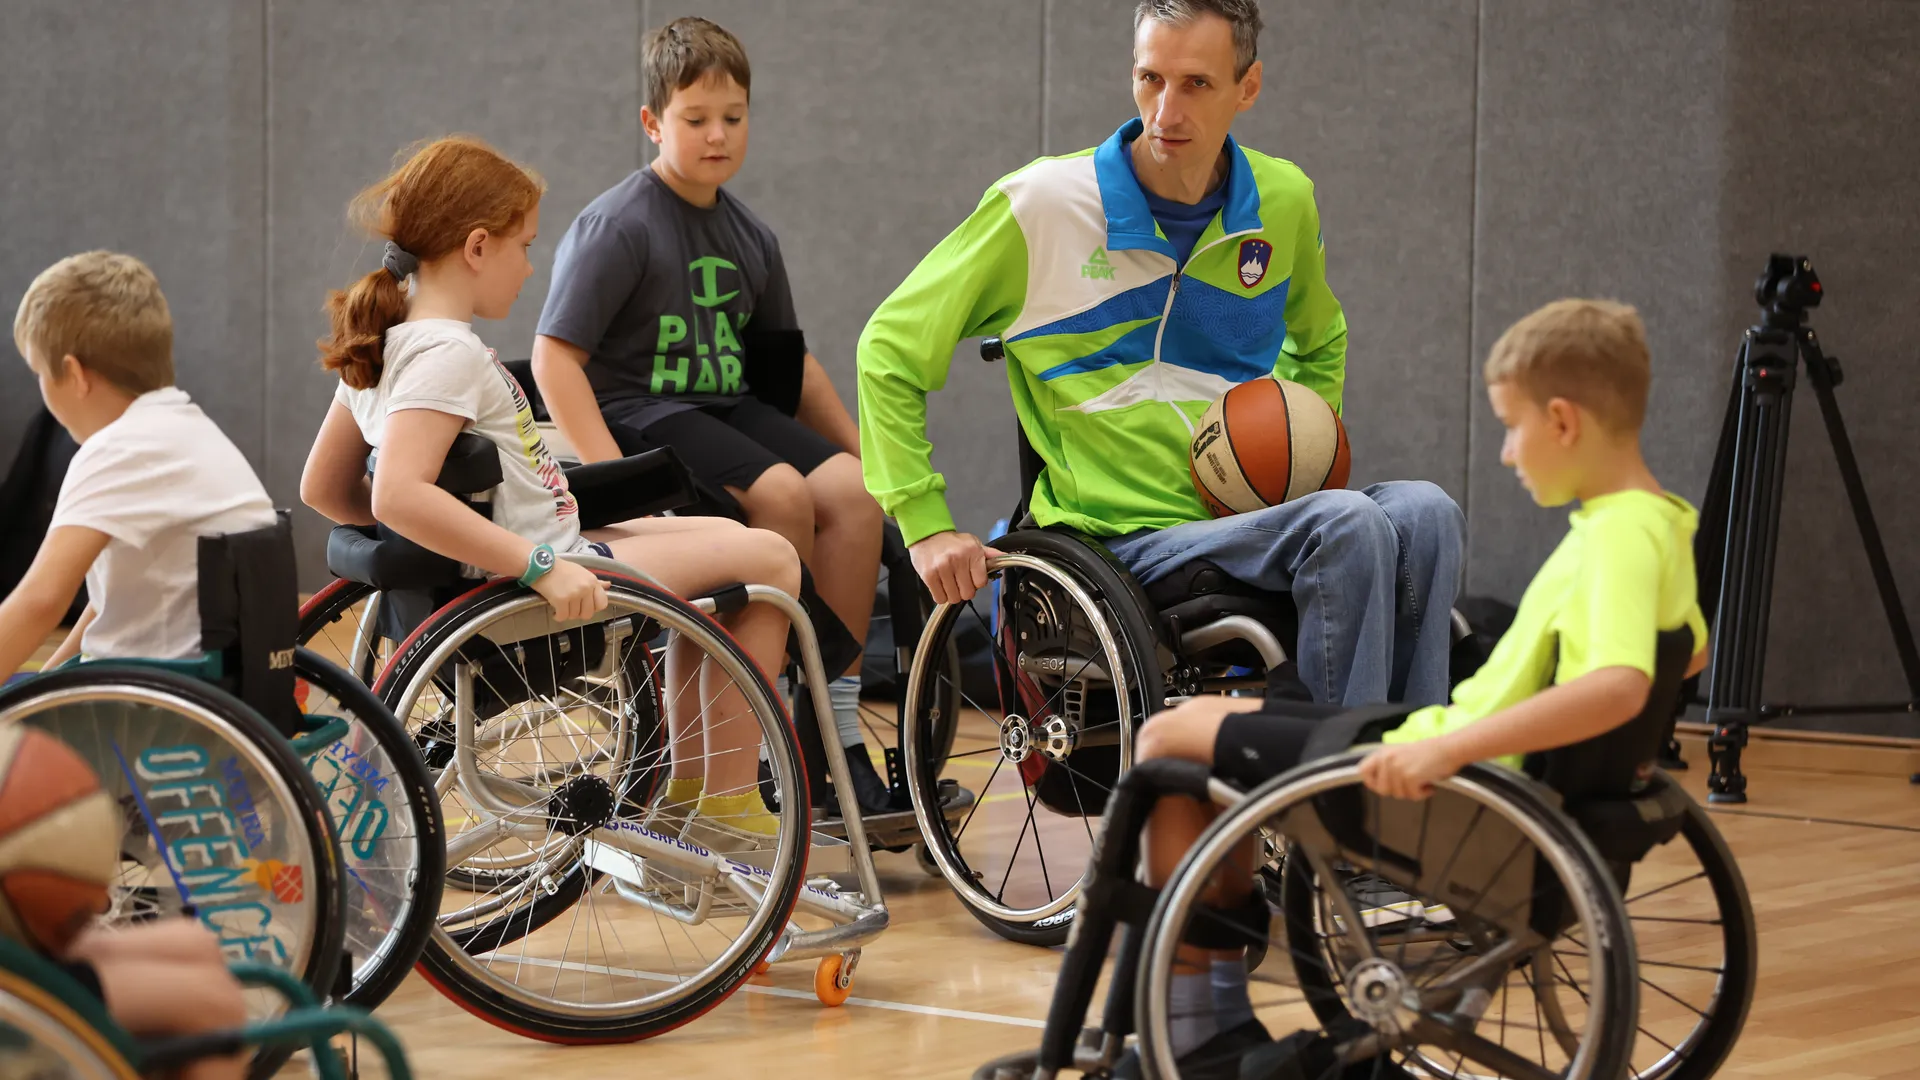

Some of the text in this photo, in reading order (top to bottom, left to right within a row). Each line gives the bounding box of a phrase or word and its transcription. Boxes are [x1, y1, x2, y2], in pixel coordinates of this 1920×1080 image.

[1081, 264, 1117, 281] PEAK
[650, 355, 742, 394] HAR
[269, 648, 295, 670] MEY
[395, 632, 429, 675] KENDA
[418, 786, 435, 834] KENDA
[620, 821, 709, 858] BAUERFEIND
[1032, 907, 1078, 927] ERGY
